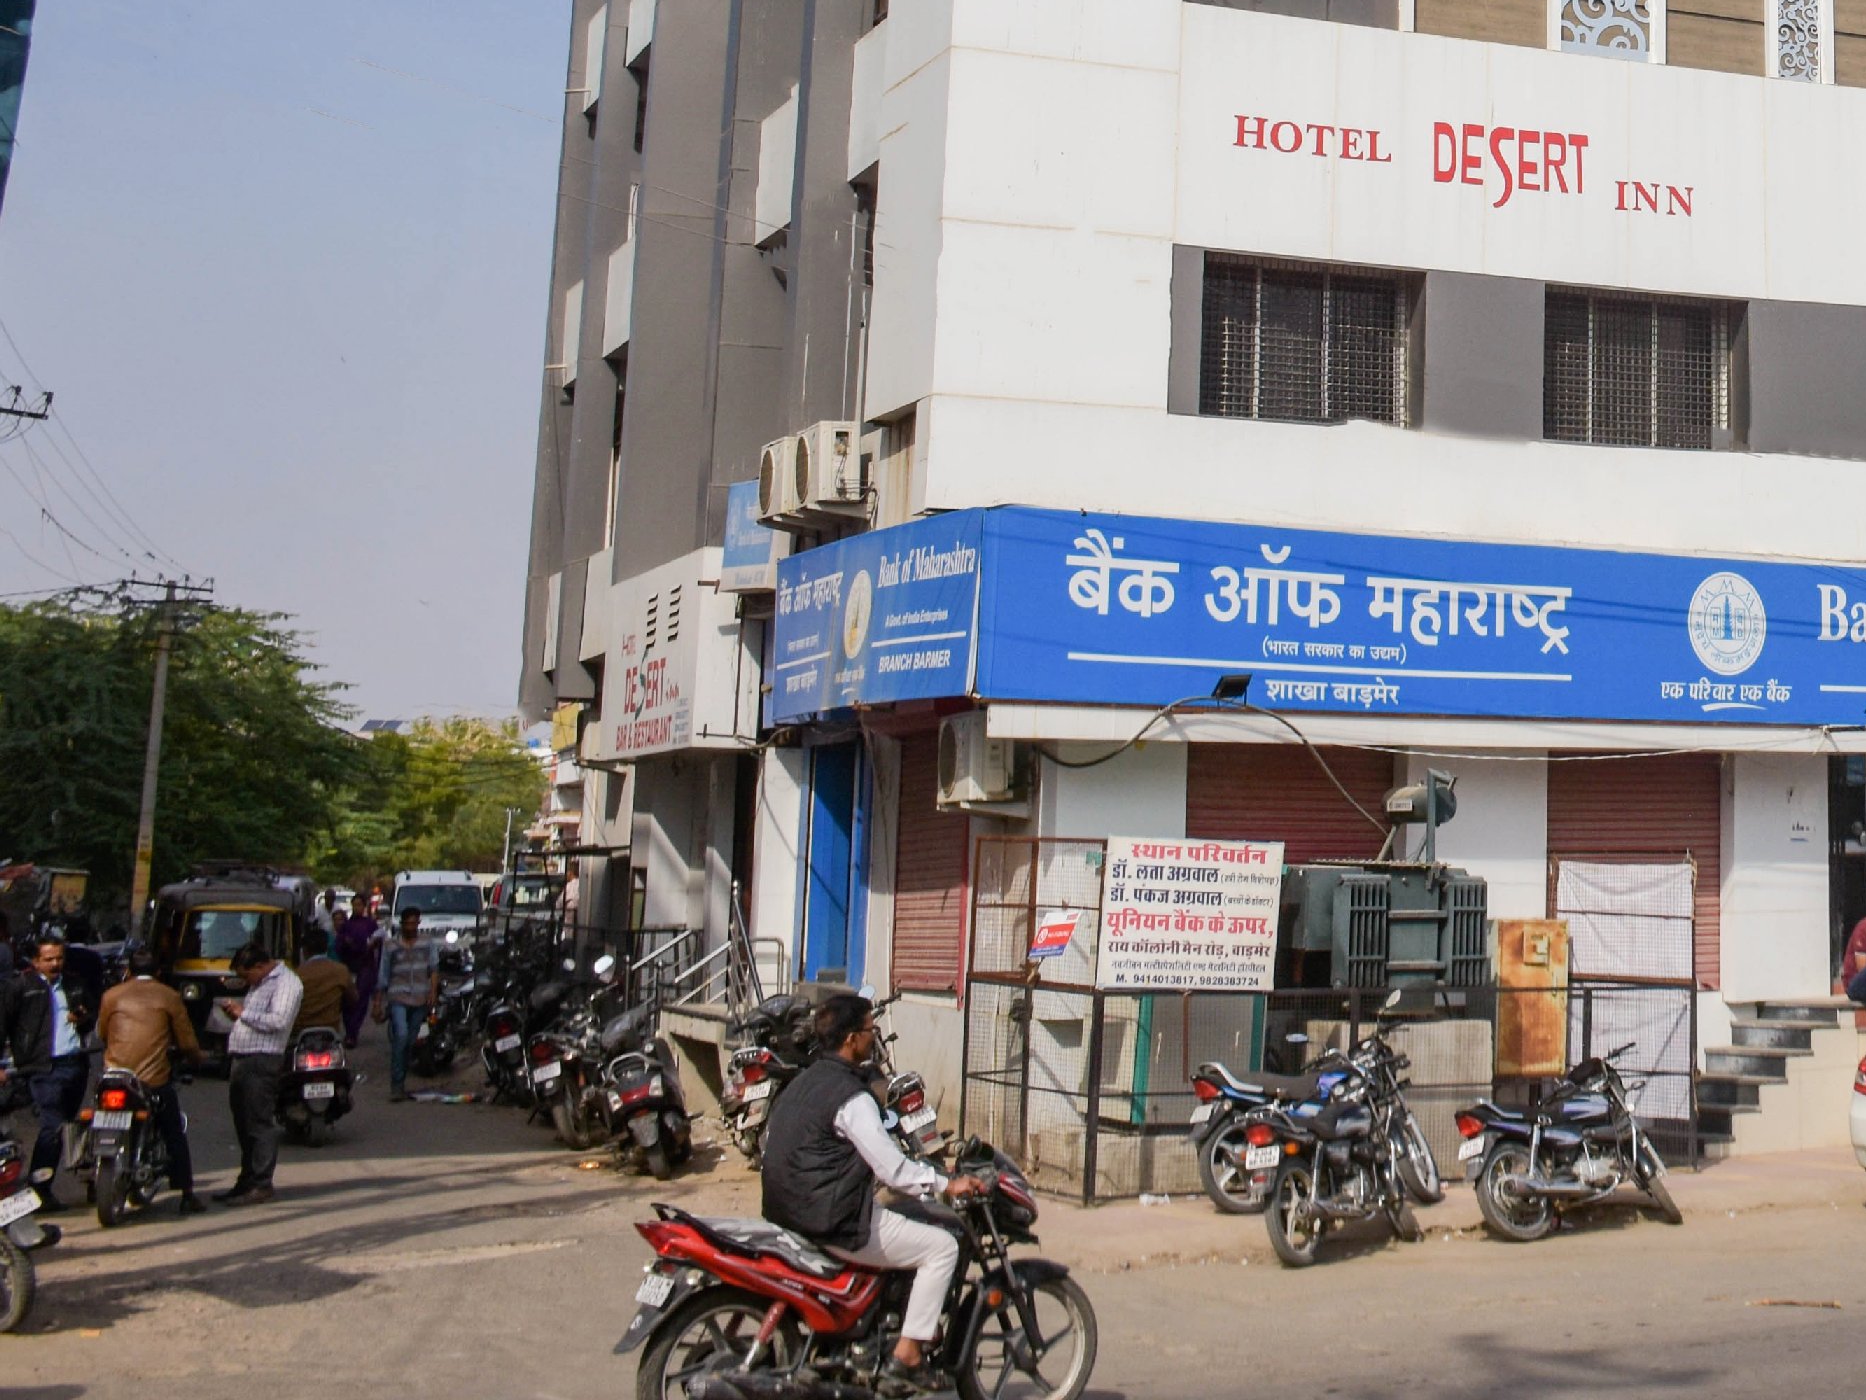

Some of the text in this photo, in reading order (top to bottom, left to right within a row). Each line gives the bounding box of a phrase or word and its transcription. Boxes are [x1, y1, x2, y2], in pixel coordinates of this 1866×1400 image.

[1232, 114, 1694, 217] HOTEL DESERT INN
[877, 540, 976, 588] Bank of Maharashtra
[1066, 528, 1572, 655] बैंक ऑफ महाराष्ट्र
[1262, 635, 1299, 658] (भारत
[1304, 642, 1345, 659] सरकार
[1349, 644, 1365, 659] का
[879, 650, 950, 673] BRANCH BARMER
[1265, 676, 1400, 709] शाखा बाड़मेर
[1661, 676, 1792, 703] एक परिवार एक बैंक
[1132, 843, 1268, 864] स्थान परिवर्तन
[1112, 858, 1132, 879] डॉ.
[1136, 864, 1164, 881] लता
[1167, 866, 1220, 883] अग्रवाल
[1111, 883, 1129, 903] डॉ.
[1133, 883, 1170, 904] पंकज
[1172, 889, 1223, 906] अग्रवाल
[1107, 908, 1273, 938] यूनियन बैंक के ऊपर,
[1108, 941, 1131, 954] राय
[1116, 973, 1128, 984] M.
